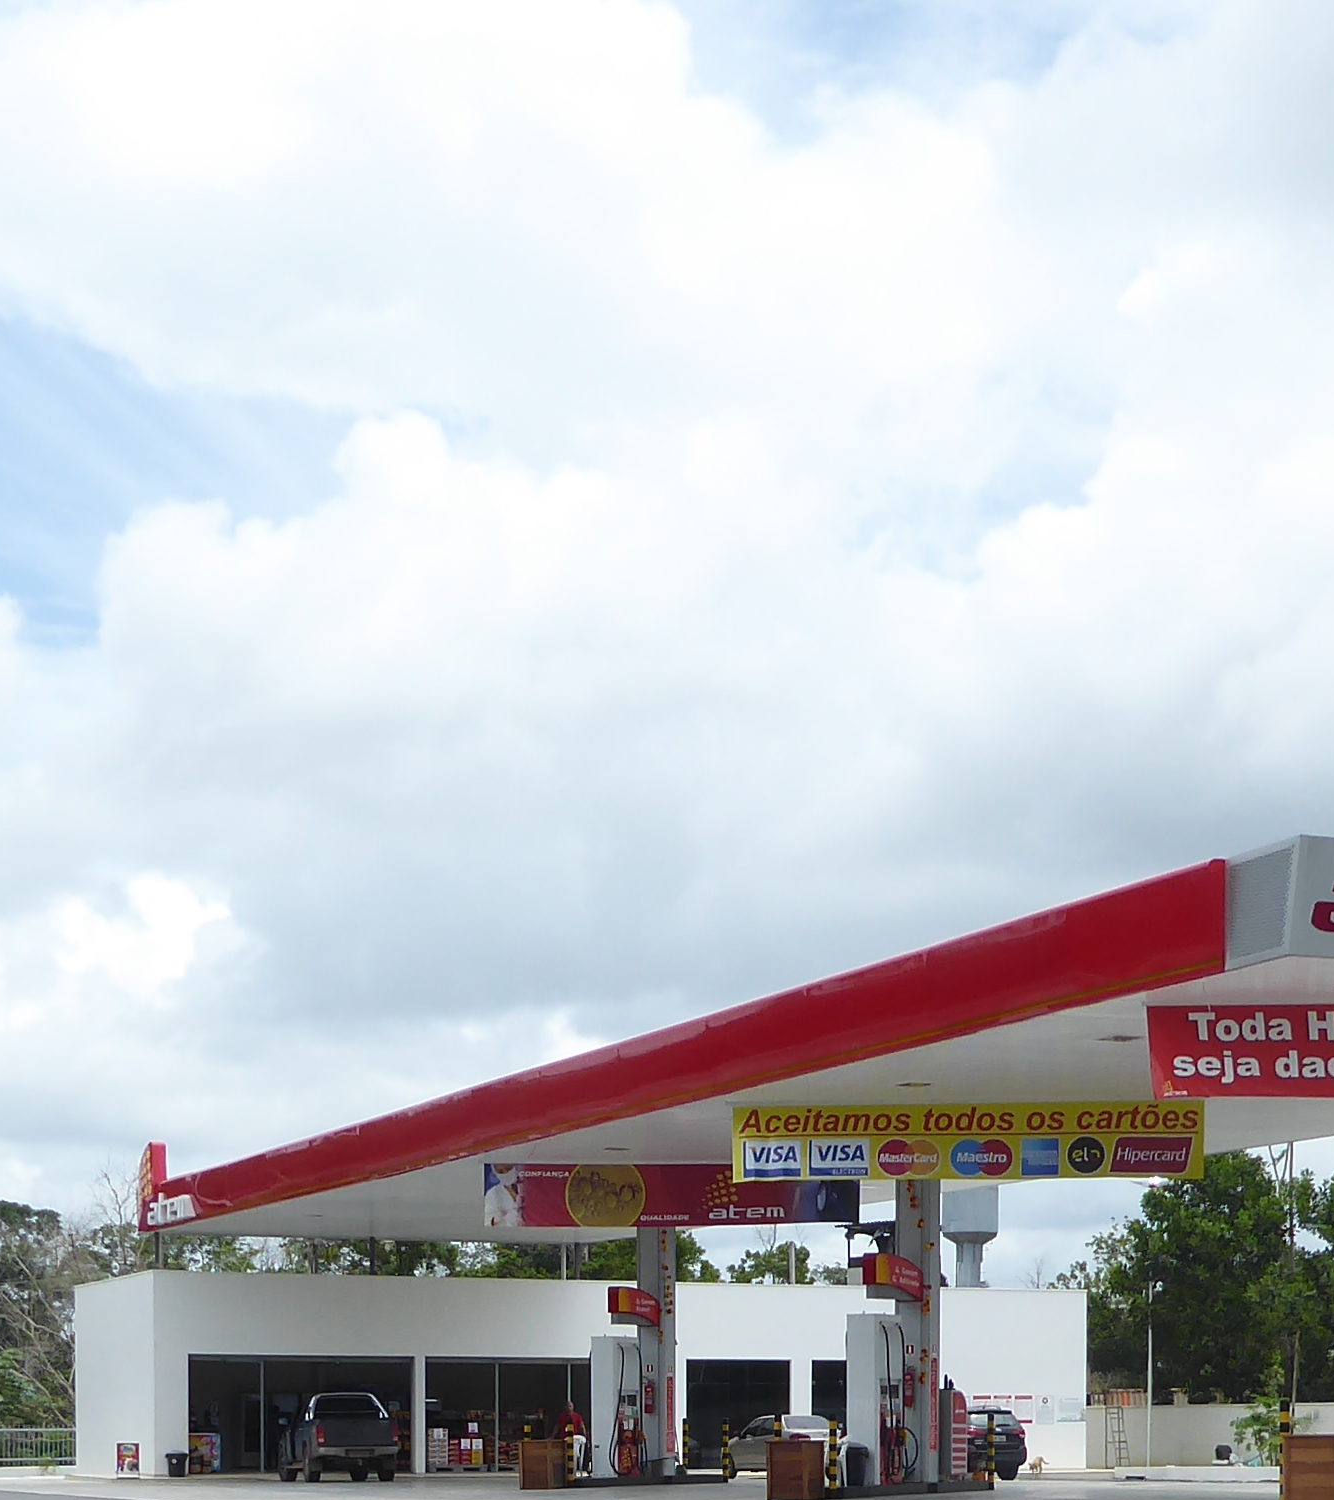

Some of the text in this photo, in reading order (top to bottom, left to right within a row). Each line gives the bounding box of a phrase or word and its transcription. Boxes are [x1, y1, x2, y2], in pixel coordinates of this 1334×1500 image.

[1188, 1011, 1292, 1042] Toda
[1172, 1050, 1261, 1084] seja
[739, 1104, 1199, 1134] Aceitamos todos os cartões
[750, 1146, 798, 1164] VISA
[817, 1144, 865, 1162] VISA
[879, 1152, 938, 1164] MasterCard
[956, 1151, 1007, 1163] Maestro
[1116, 1147, 1186, 1163] Hipercard
[640, 1214, 690, 1222] QUALIDADE
[708, 1204, 785, 1219] atem
